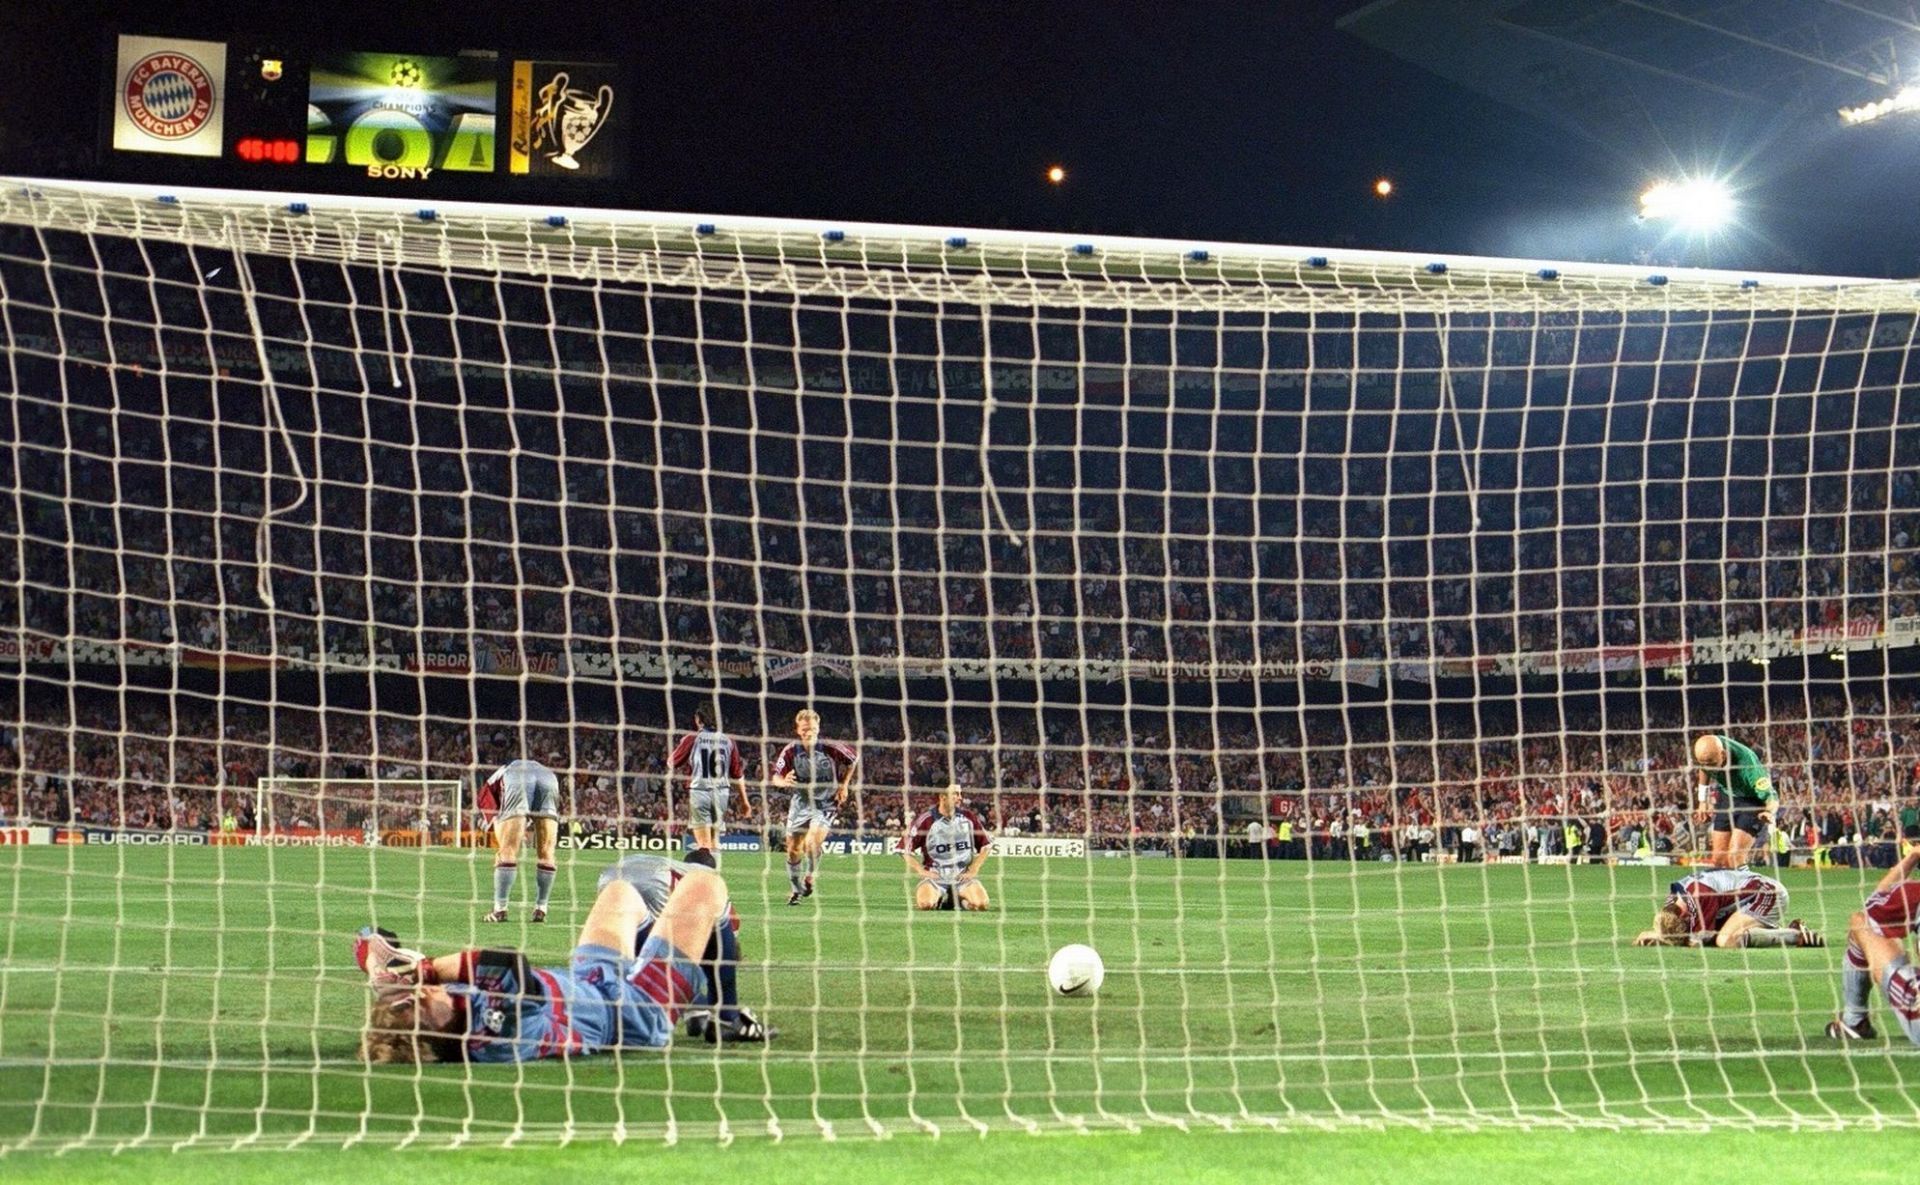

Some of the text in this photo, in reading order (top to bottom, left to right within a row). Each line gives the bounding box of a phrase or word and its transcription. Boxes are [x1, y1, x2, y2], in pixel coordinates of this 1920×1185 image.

[133, 57, 207, 89] FC BAYERN
[193, 99, 209, 120] EV
[367, 164, 433, 180] SONY
[1245, 659, 1332, 677] MANICS
[700, 748, 726, 779] 16
[88, 832, 204, 846] EUROCARD
[245, 833, 358, 847] McDonald's
[558, 834, 681, 850] ayStation
[719, 842, 760, 850] MBRO
[935, 841, 972, 855] OPEL
[1007, 844, 1063, 857] LEAGUE
